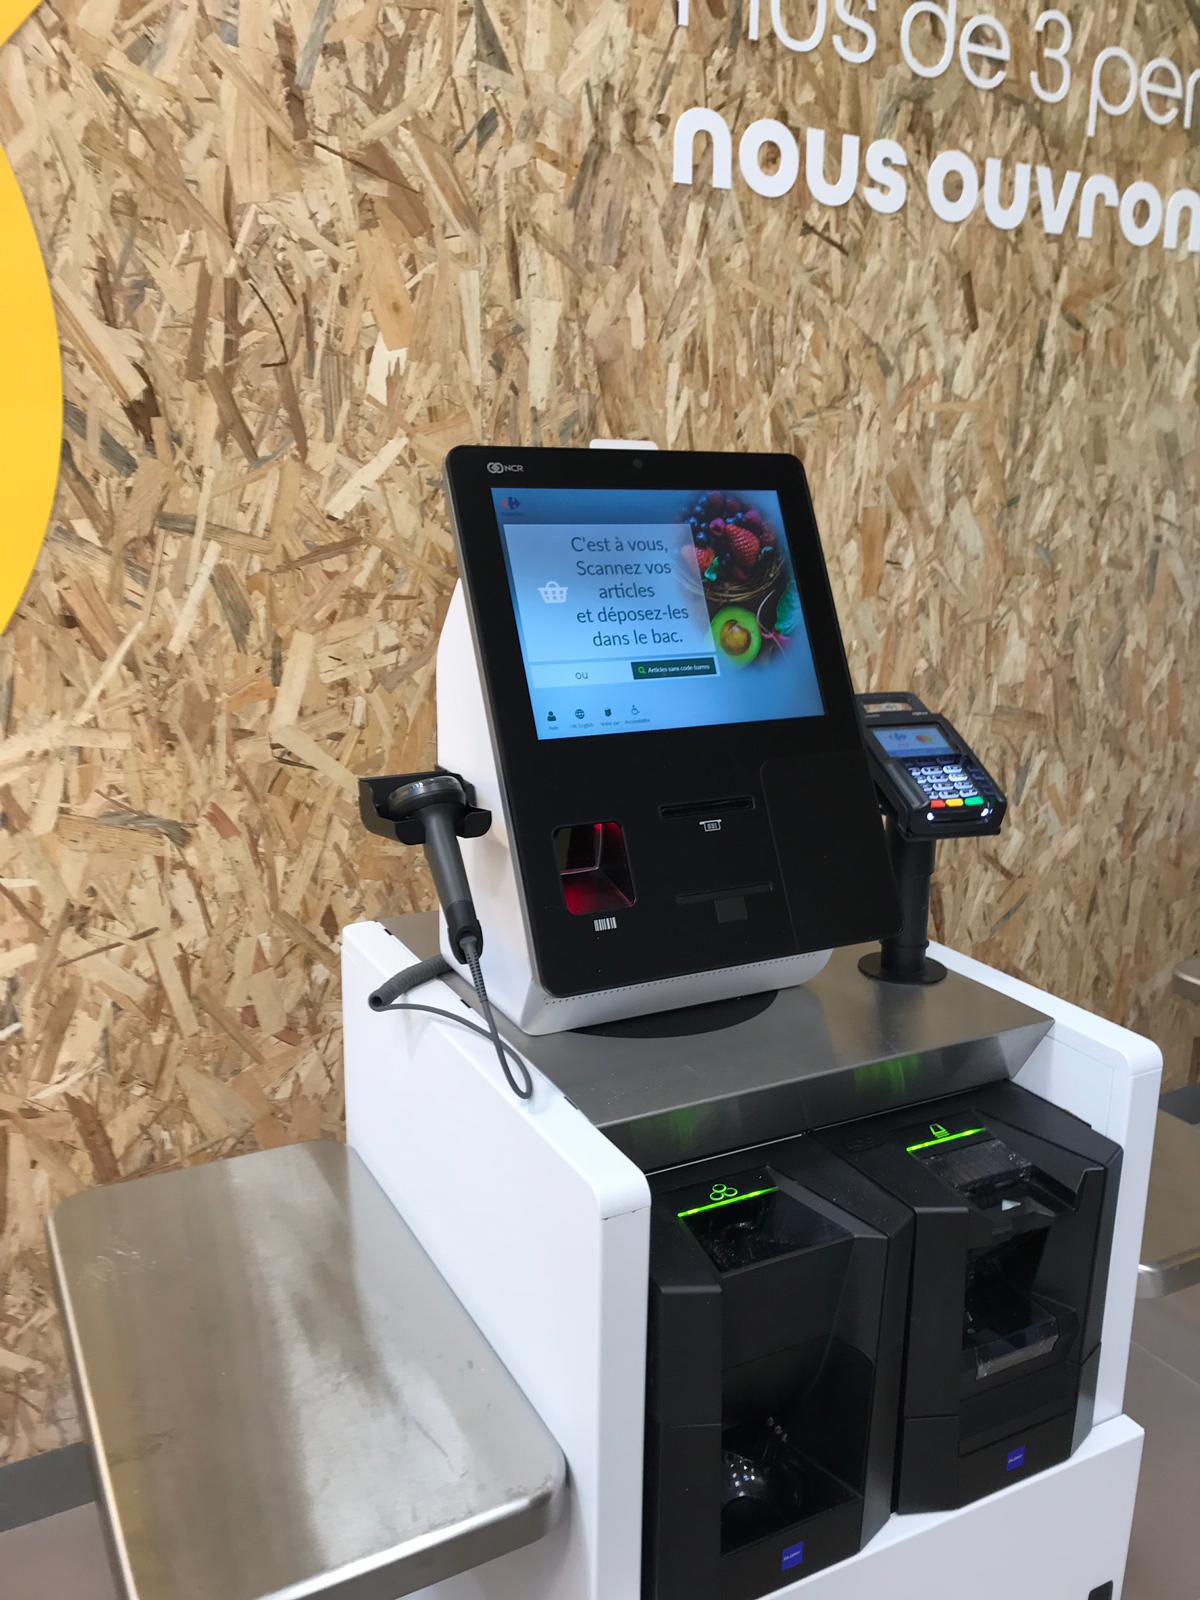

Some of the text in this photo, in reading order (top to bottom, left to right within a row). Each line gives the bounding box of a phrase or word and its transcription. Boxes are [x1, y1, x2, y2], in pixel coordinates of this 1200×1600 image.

[678, 0, 877, 64] us
[901, 0, 1010, 90] de
[1030, 9, 1072, 103] 3
[673, 107, 1200, 252] nous ouvron
[504, 464, 524, 472] NCR
[570, 536, 669, 553] C'est à vous,
[576, 560, 672, 576] Scannez vos
[599, 582, 655, 599] articles
[576, 604, 689, 625] et déposez-les
[592, 628, 683, 647] dans le bac.
